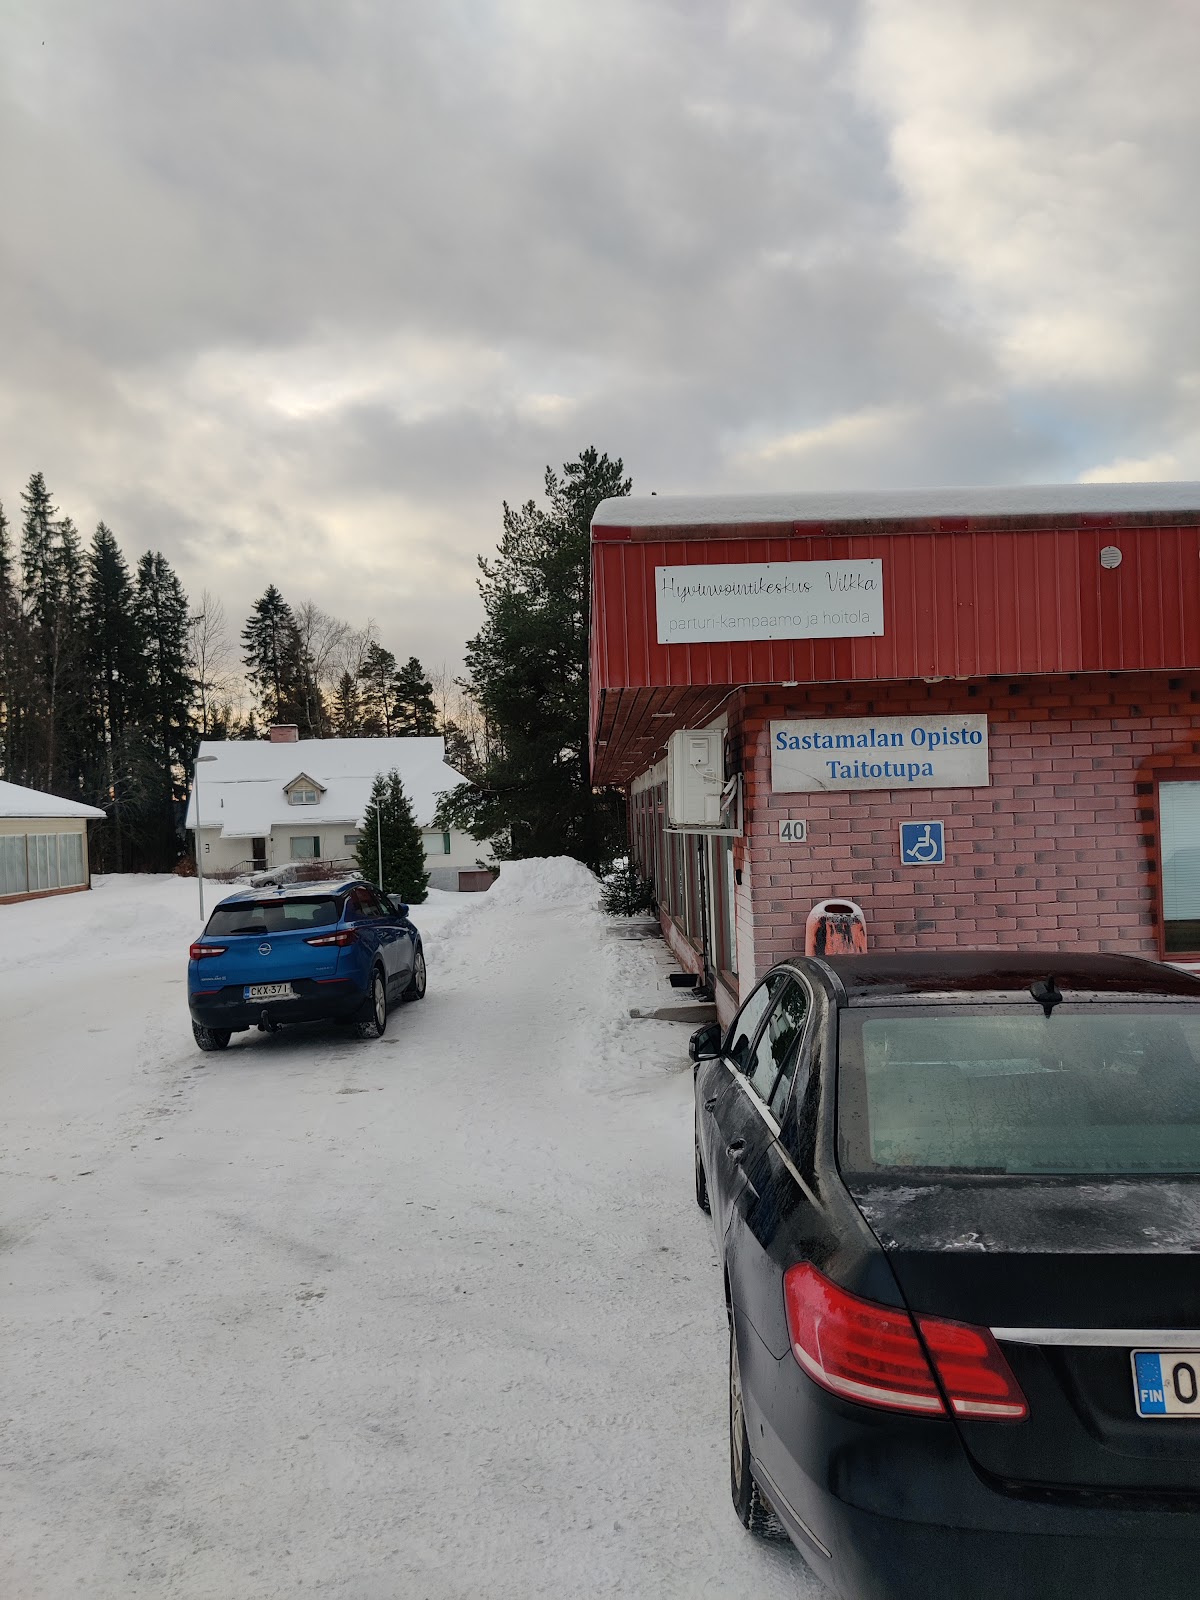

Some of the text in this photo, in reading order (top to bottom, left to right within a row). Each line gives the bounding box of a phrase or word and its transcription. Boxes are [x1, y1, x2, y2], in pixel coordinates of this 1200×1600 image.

[661, 571, 878, 603] Hyvinvointikeskus Vilkka
[669, 609, 871, 632] parturi-kampaamo ja hoitola
[776, 726, 983, 751] Sastamalan Opisto
[826, 760, 934, 782] Taitotupa
[781, 821, 804, 841] 40
[1141, 1389, 1163, 1402] FIN
